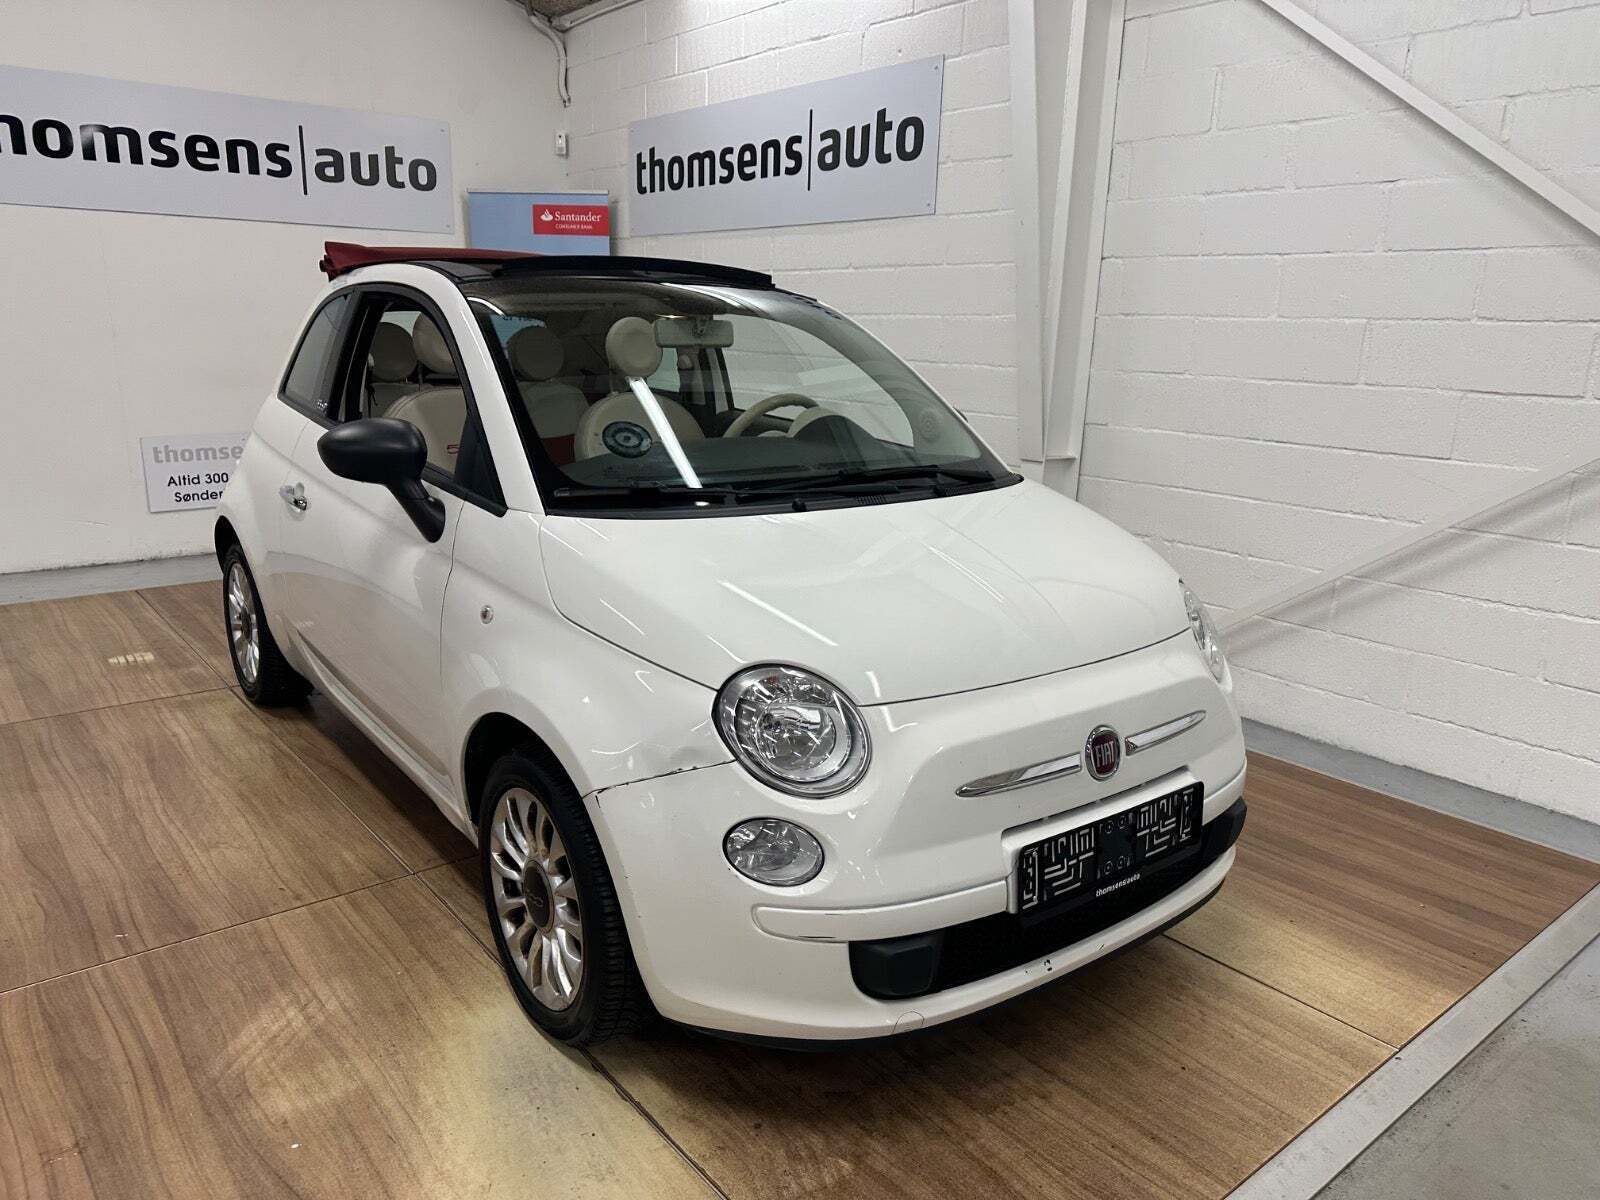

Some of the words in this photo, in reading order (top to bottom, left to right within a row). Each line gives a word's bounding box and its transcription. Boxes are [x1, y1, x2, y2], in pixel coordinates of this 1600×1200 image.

[554, 211, 602, 222] Santander
[152, 444, 244, 464] thomse
[167, 474, 201, 487] Altid
[204, 472, 229, 485] 300
[174, 489, 224, 503] Sønder
[1094, 740, 1115, 768] FIAT
